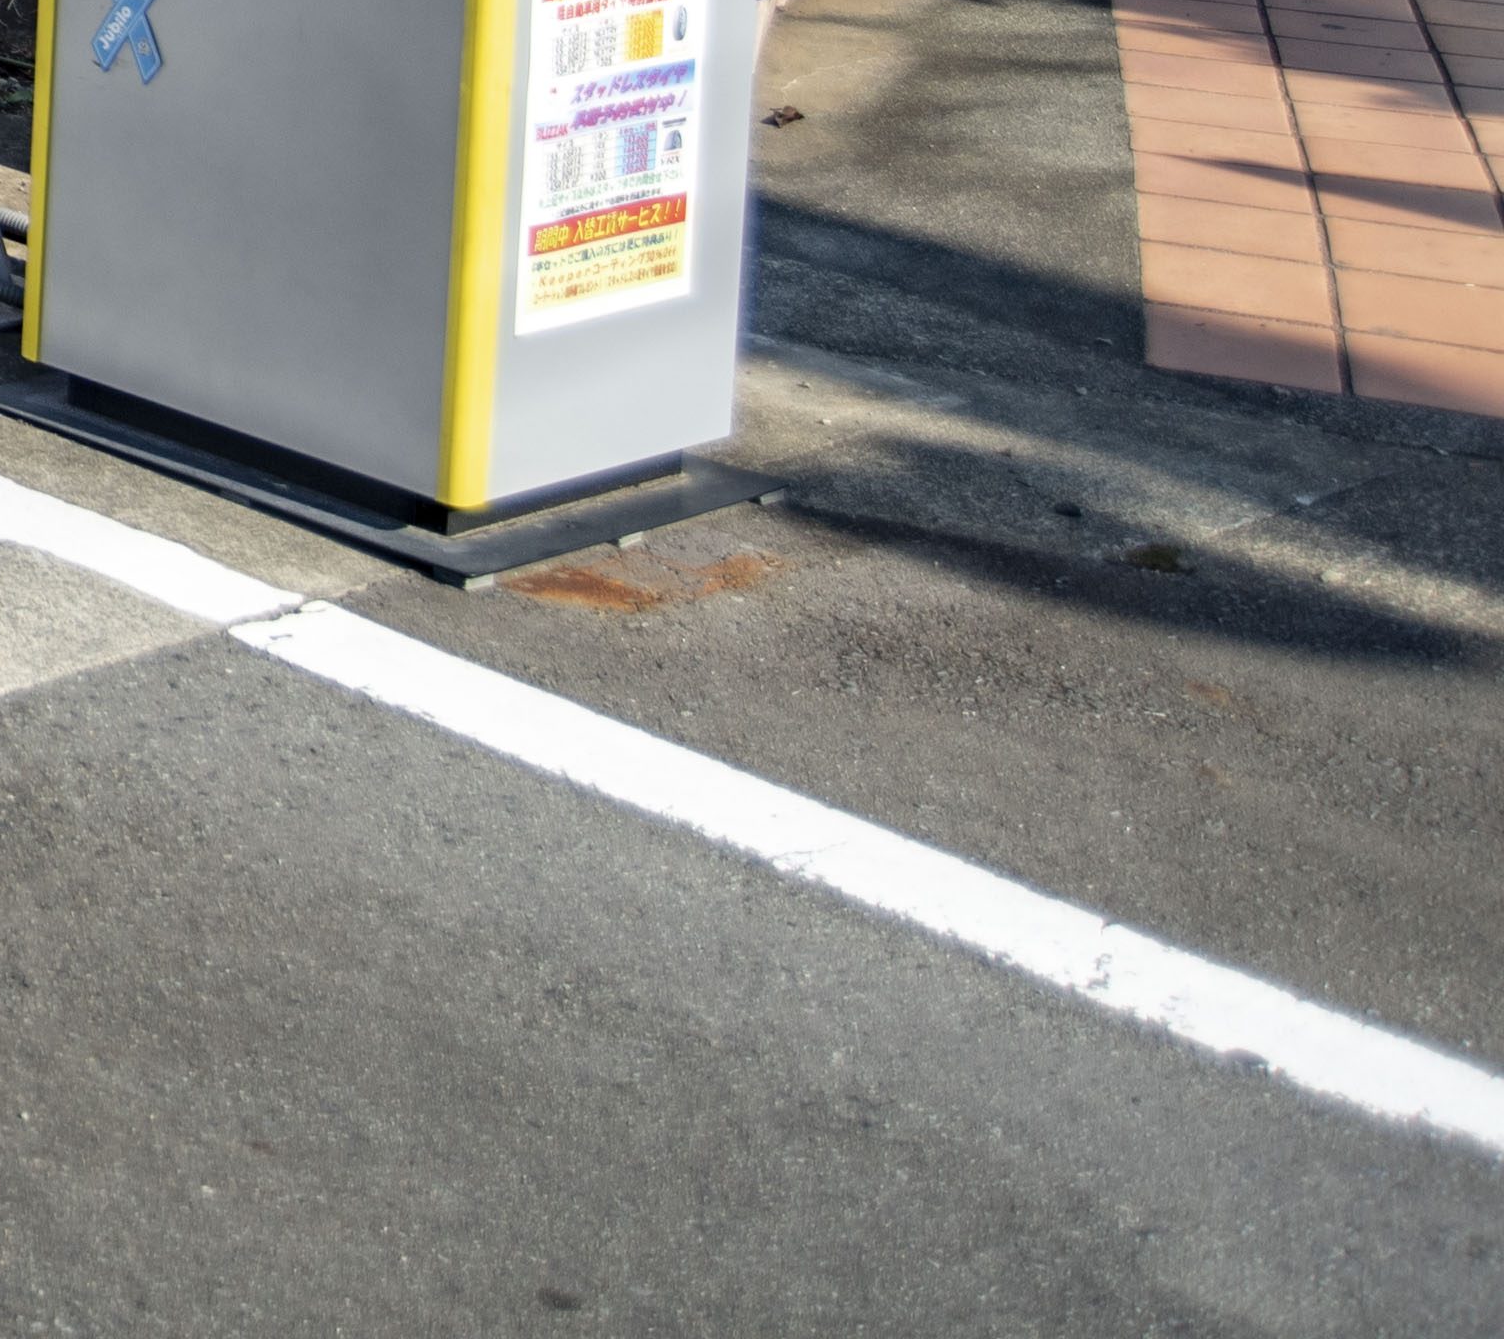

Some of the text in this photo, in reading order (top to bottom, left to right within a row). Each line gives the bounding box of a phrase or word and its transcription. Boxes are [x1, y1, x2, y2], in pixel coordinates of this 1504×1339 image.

[571, 65, 689, 104] スタッドレスタイヤ
[534, 223, 570, 253] 期間中
